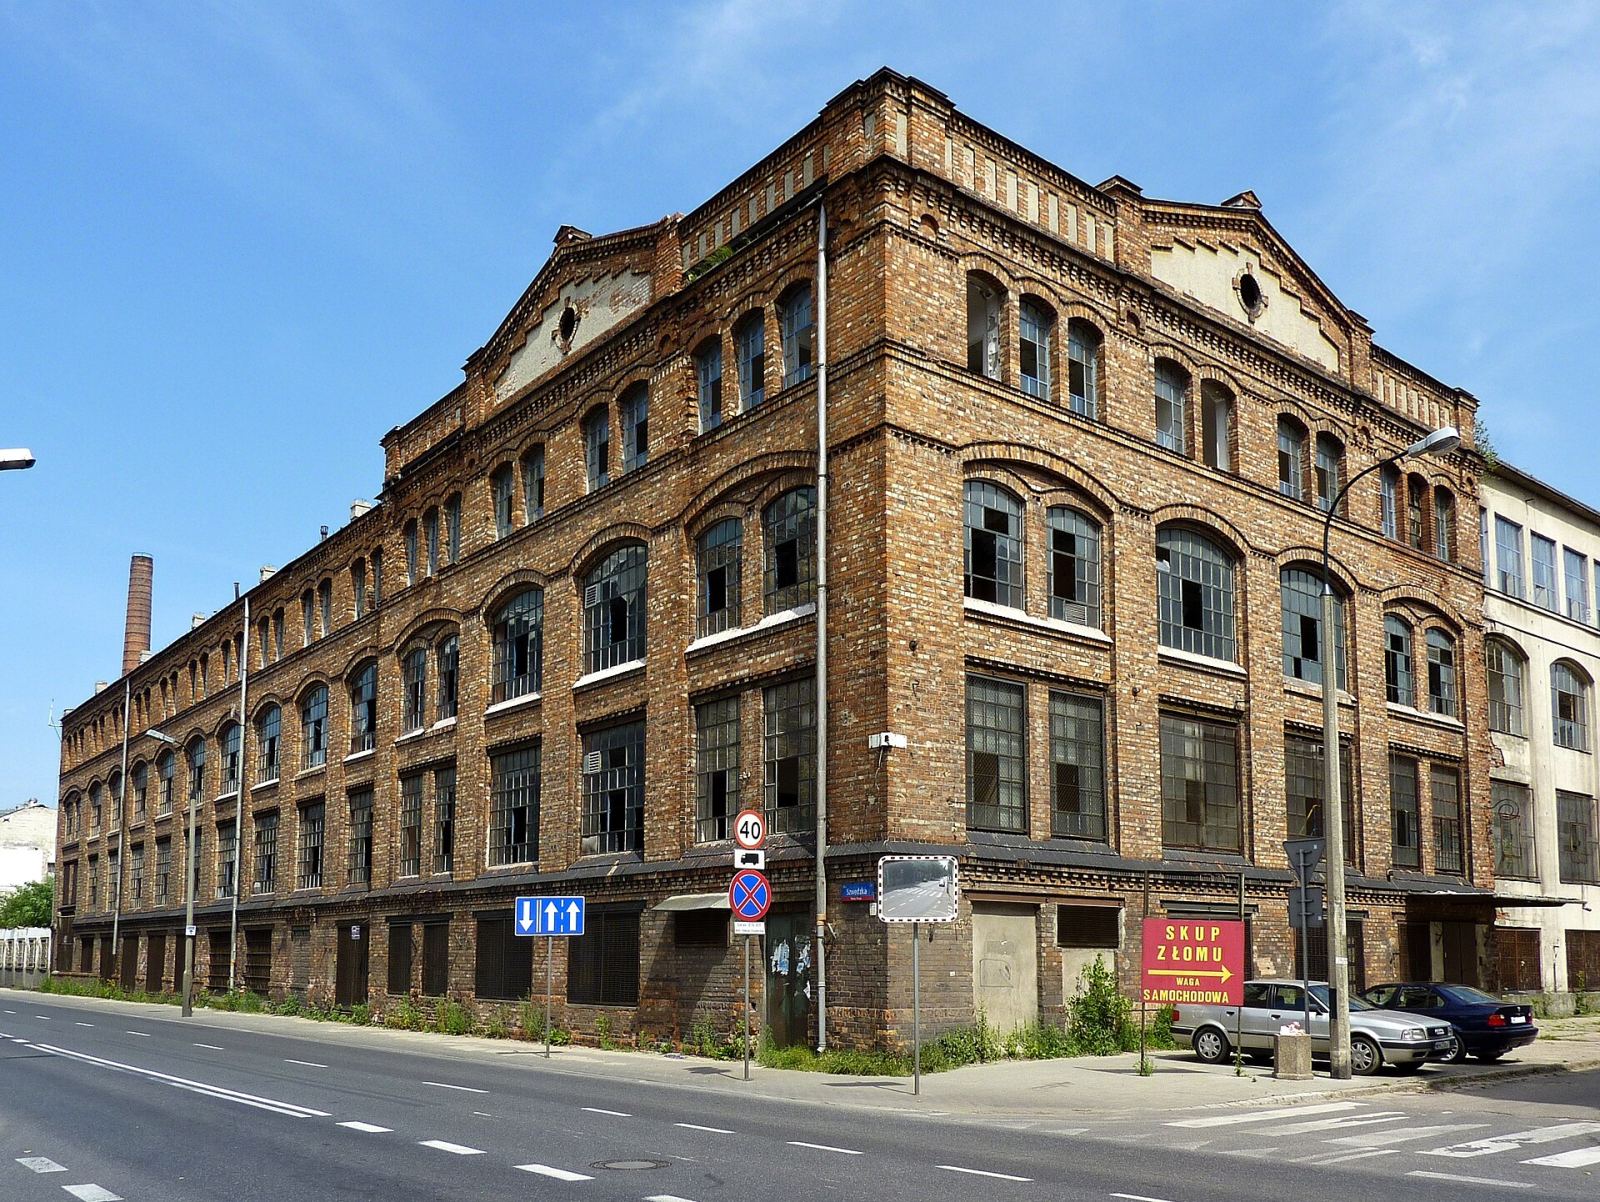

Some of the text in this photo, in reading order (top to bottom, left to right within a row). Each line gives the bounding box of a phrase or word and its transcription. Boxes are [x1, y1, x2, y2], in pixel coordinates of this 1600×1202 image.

[740, 821, 761, 840] 40
[1165, 925, 1220, 941] SKUP
[1157, 945, 1222, 962] ZŁOMU
[1176, 977, 1200, 986] WAGA
[1143, 989, 1229, 1003] SAMOCHODOWA
